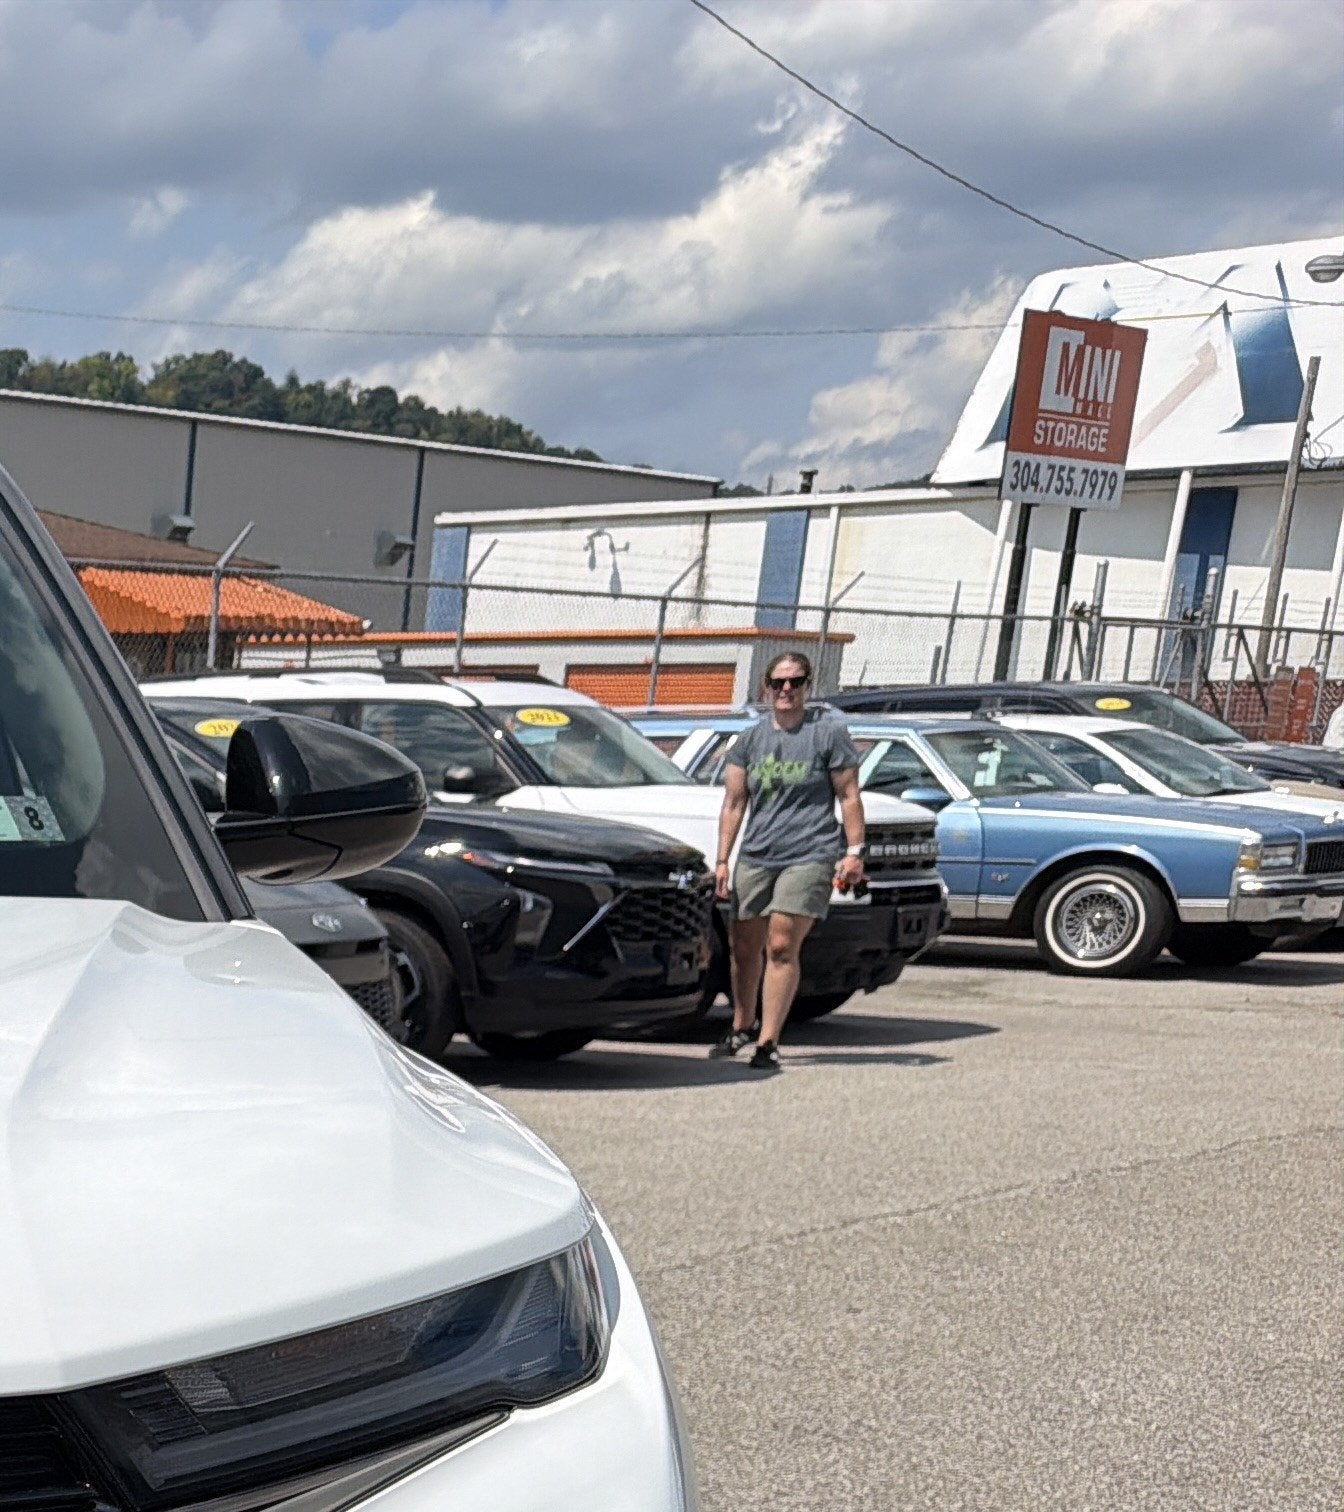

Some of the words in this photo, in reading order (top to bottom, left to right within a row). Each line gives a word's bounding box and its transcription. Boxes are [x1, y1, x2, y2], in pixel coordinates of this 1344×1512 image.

[1048, 334, 1122, 406] MINI
[1033, 420, 1110, 453] STORAGE
[1009, 459, 1119, 501] 304.755.7979
[23, 806, 45, 831] 8
